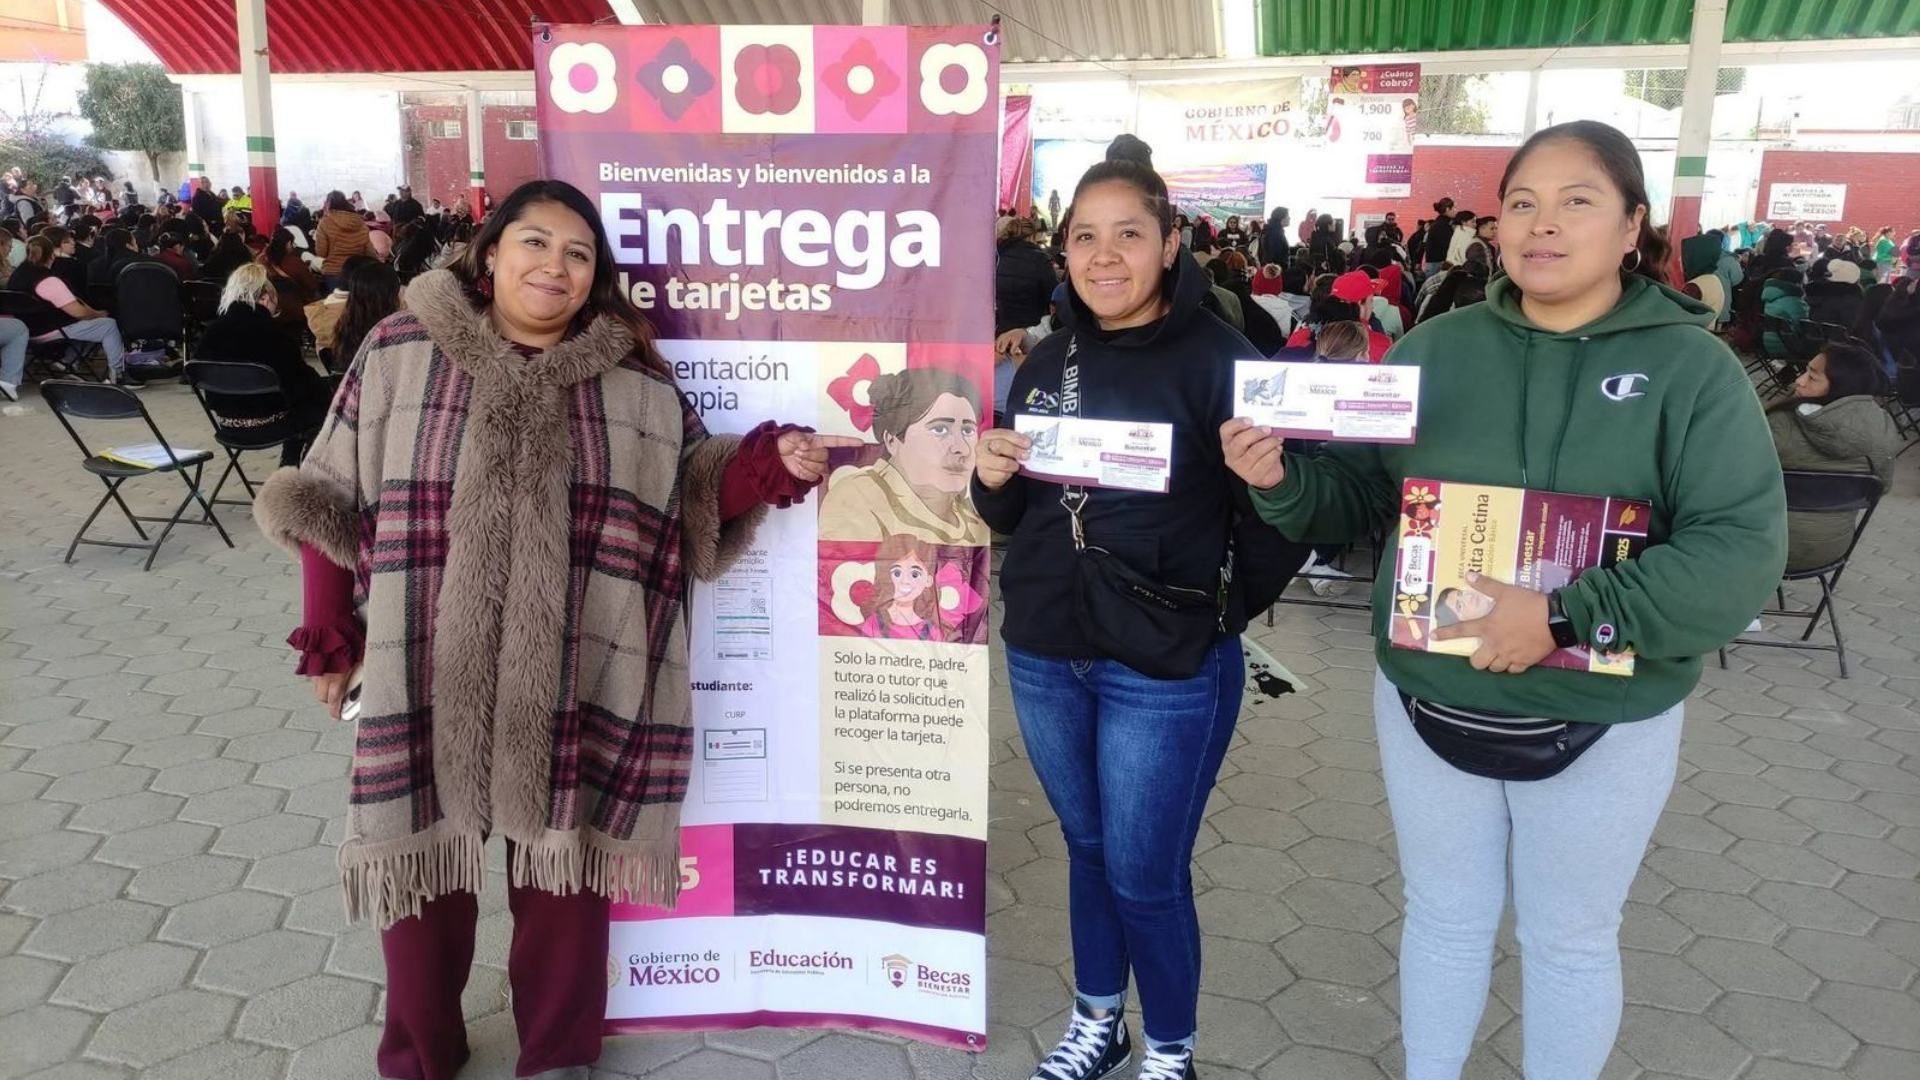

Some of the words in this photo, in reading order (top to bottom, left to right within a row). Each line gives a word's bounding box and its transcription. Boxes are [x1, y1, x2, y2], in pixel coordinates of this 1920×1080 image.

[1380, 79, 1413, 88] cobro?
[1185, 104, 1268, 119] GOBIERNO
[1272, 100, 1291, 115] DE
[1359, 103, 1393, 116] 1,900
[1186, 119, 1290, 142] MÉXICO
[1363, 131, 1383, 142] 700
[599, 162, 732, 183] Bienvenidas
[737, 168, 750, 188] y
[755, 163, 887, 184] bienvenidos
[893, 169, 905, 184] a
[911, 164, 931, 184] la
[600, 191, 941, 289] Entrega
[665, 272, 832, 321] tarjetas
[664, 354, 789, 381] entación
[684, 385, 739, 418] opia
[1062, 365, 1079, 417] BIMB
[1470, 493, 1489, 545] Cetina
[1519, 529, 1535, 583] Bienestar
[1616, 537, 1630, 562] 2025
[834, 651, 862, 664] Solo
[865, 652, 876, 665] la
[880, 655, 925, 670] madre,
[929, 658, 968, 673] padre,
[690, 680, 753, 691] studiante:
[834, 671, 874, 684] tutora
[877, 674, 885, 685] o
[888, 673, 920, 686] tutor
[924, 677, 948, 691] que
[834, 688, 877, 702] realizó
[879, 690, 890, 703] la
[893, 692, 946, 707] solicitud
[948, 698, 965, 709] en
[724, 711, 746, 719] CURP
[834, 706, 845, 719] la
[848, 707, 920, 723] plataforma
[923, 714, 964, 728] puede
[834, 726, 884, 742] recoger
[887, 727, 898, 741] la
[901, 730, 946, 746] tarjeta.
[834, 760, 845, 774] Si
[848, 764, 863, 775] se
[866, 765, 922, 779] presenta
[925, 769, 951, 782] otra
[834, 781, 891, 797] persona,
[894, 785, 911, 796] no
[834, 799, 901, 814] podremos
[904, 804, 973, 822] entregarla.
[786, 849, 897, 872] ¡EDUCAR
[910, 857, 937, 875] ES
[759, 869, 964, 899] TRANSFORMAR!
[629, 951, 699, 965] Gobierno
[704, 950, 720, 961] de
[750, 949, 853, 969] Educación
[629, 964, 720, 987] México
[917, 964, 971, 986] Becas
[917, 981, 971, 994] BIENESTAR
